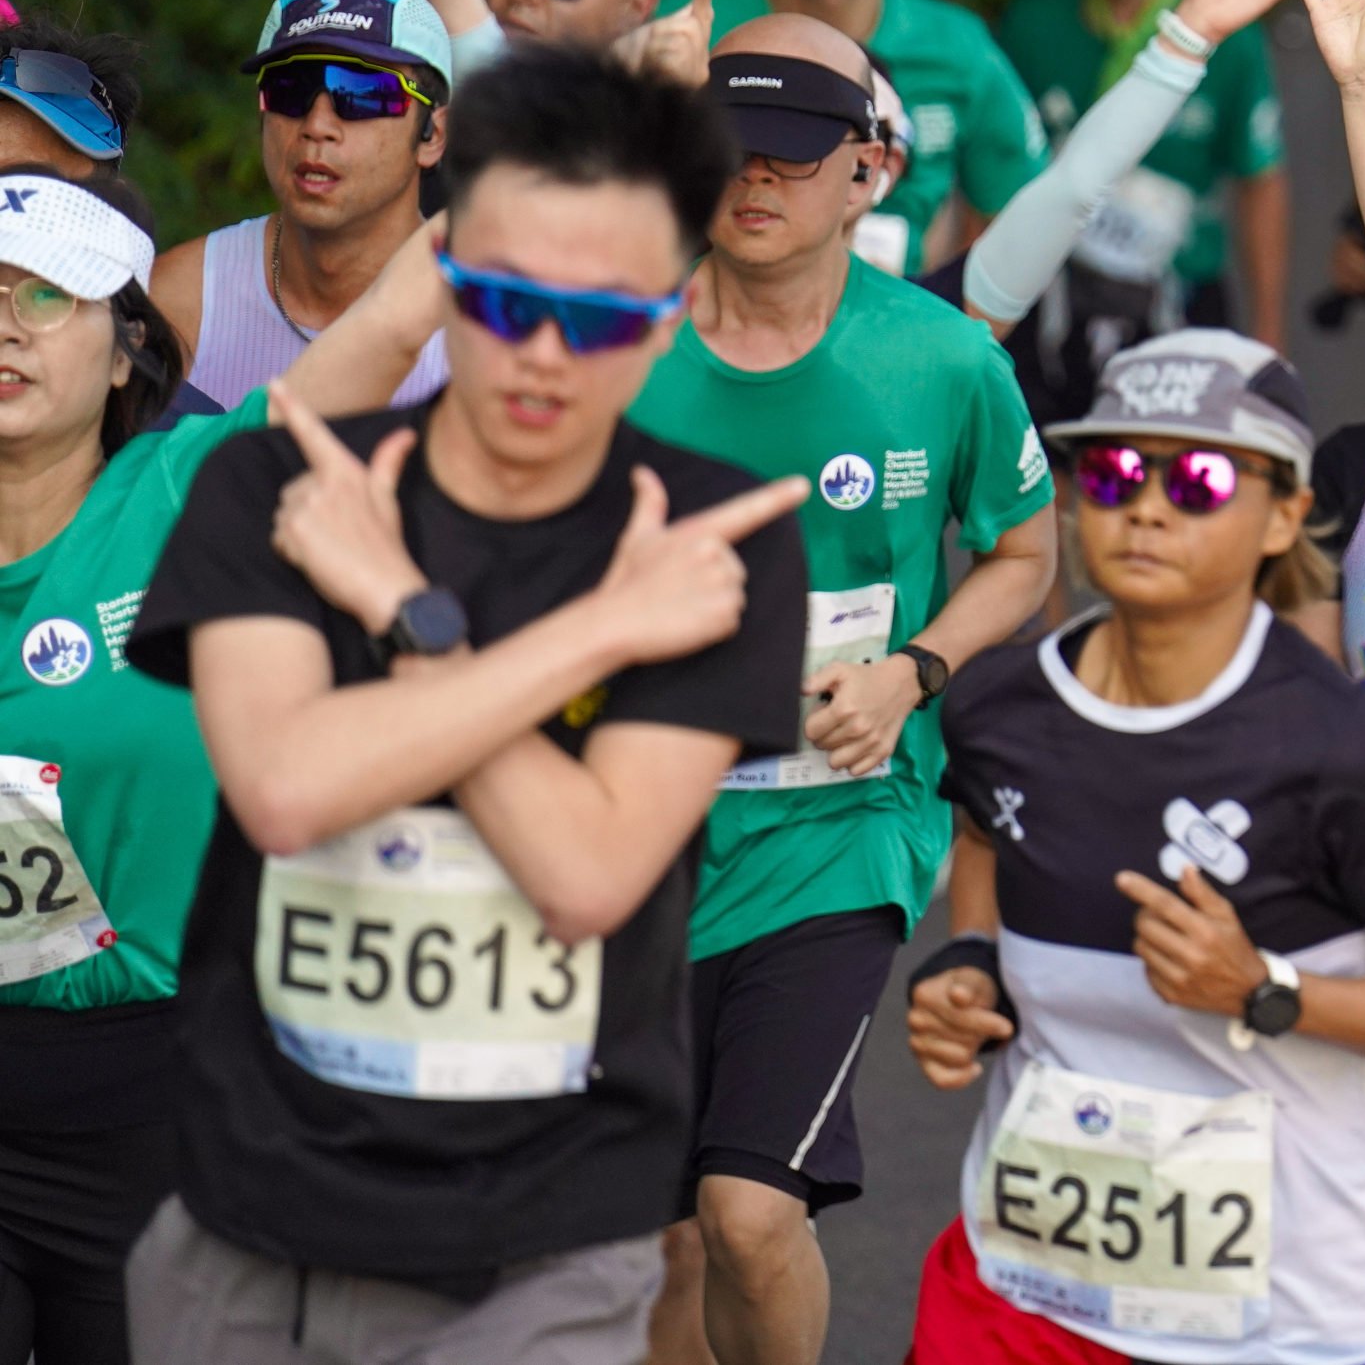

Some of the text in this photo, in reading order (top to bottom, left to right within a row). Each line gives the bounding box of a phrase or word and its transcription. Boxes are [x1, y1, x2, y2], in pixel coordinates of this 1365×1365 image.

[288, 12, 373, 37] SOUTHRUN
[729, 76, 782, 89] GARMIN
[279, 905, 578, 1012] E5613
[994, 1160, 1255, 1269] E2512
